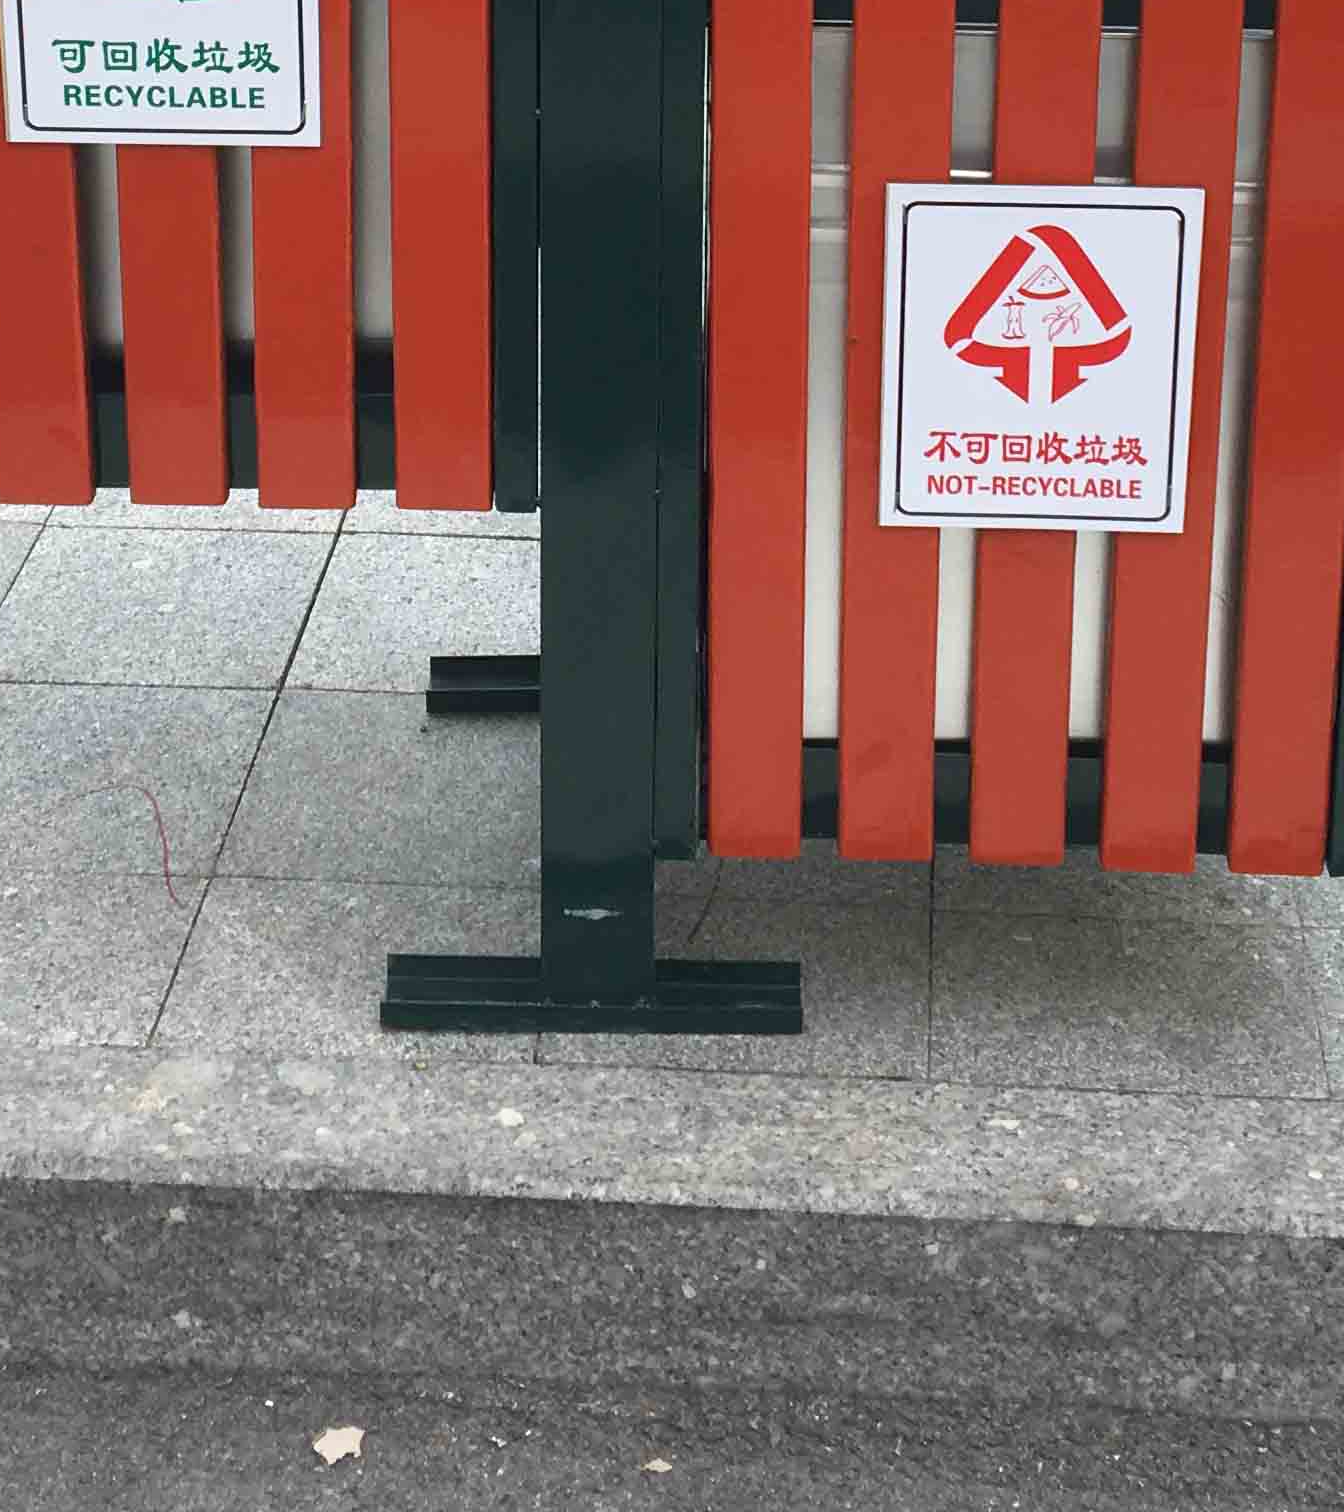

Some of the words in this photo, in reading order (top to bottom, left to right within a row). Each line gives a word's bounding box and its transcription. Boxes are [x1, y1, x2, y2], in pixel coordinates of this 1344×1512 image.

[51, 38, 280, 74] 可回收垃圾
[63, 84, 265, 109] RECYCLABLE
[923, 431, 1149, 466] 不可回收垃圾
[927, 475, 1143, 500] NOT-RECYCLABLE
